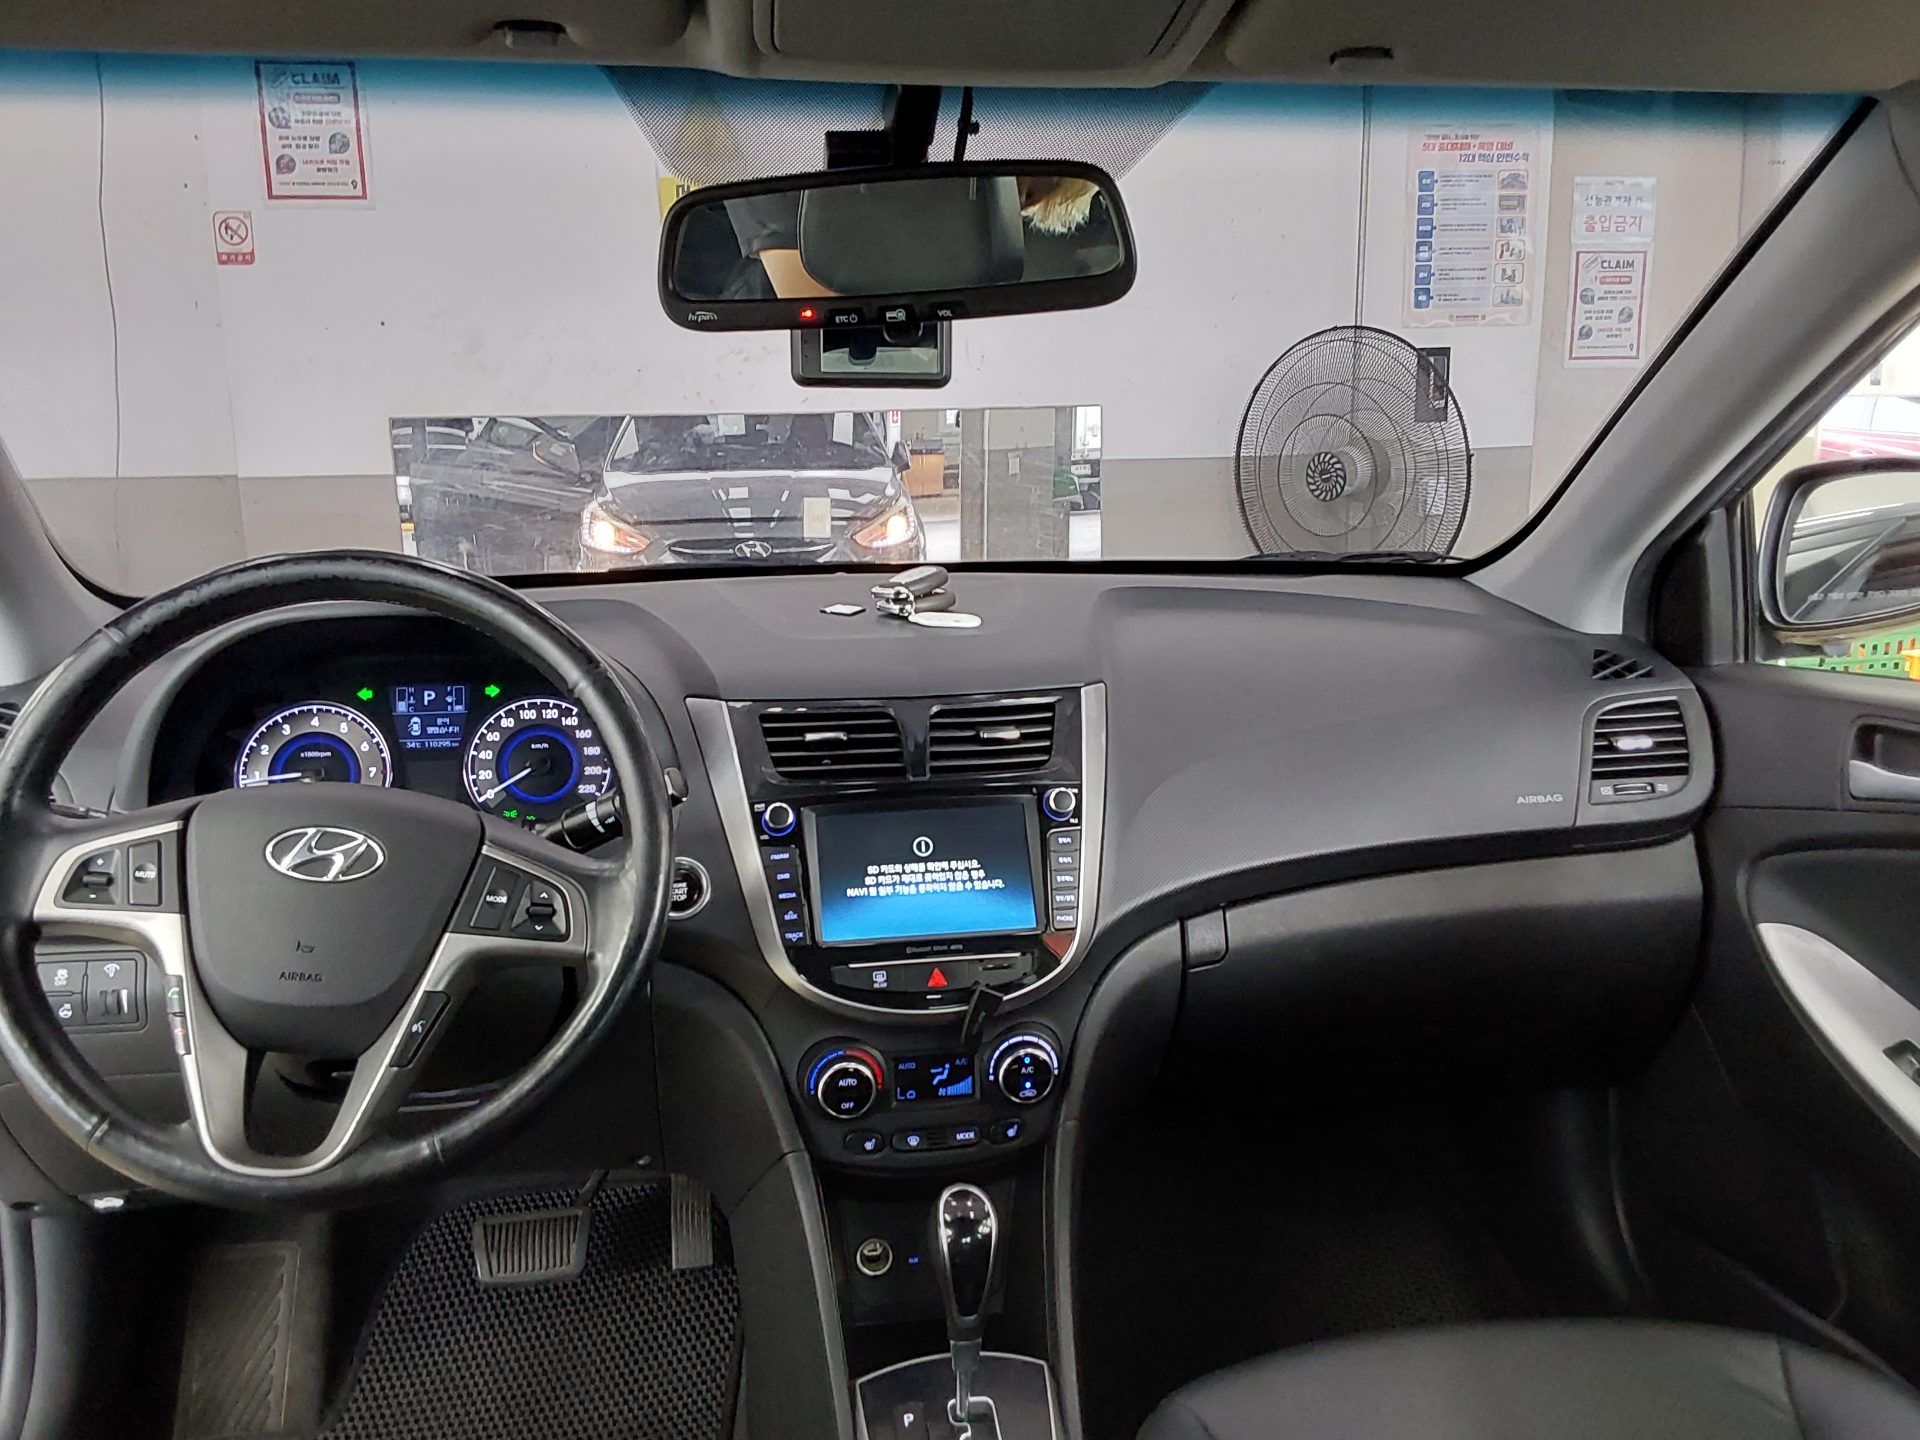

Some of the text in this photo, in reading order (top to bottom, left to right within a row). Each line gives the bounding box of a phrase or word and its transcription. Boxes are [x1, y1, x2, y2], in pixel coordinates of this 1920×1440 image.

[291, 72, 341, 84] CLAIM
[1583, 214, 1643, 233] 출입금지
[1600, 259, 1635, 269] CLAIM
[937, 309, 953, 318] VOL
[835, 315, 849, 324] ETC
[423, 690, 436, 706] P
[519, 710, 537, 720] 100
[541, 709, 559, 719] 120
[310, 716, 320, 727] 4
[500, 717, 514, 728] 80
[561, 716, 579, 726] 140
[282, 724, 291, 736] 3
[340, 722, 349, 734] 5
[486, 731, 500, 742] 60
[575, 729, 592, 739] 160
[260, 744, 270, 756] 2
[360, 741, 370, 752] 6
[583, 746, 601, 756] 180
[478, 749, 493, 760] 40
[368, 766, 377, 778] 7
[478, 769, 493, 780] 20
[584, 766, 602, 776] 200
[578, 784, 597, 794] 220
[1516, 793, 1563, 805] AIRBAG
[135, 870, 156, 878] MUTE
[867, 865, 880, 875] SD
[865, 876, 877, 885] SD
[847, 888, 868, 897] NAVI
[486, 895, 507, 903] MODE
[280, 971, 322, 982] AIRBAG
[898, 1062, 916, 1070] AUTO
[955, 1057, 969, 1066] A/C
[1021, 1066, 1034, 1074] A/C
[838, 1079, 857, 1087] AUTO
[841, 1102, 854, 1110] OFF
[956, 1131, 974, 1140] MODE
[903, 1413, 914, 1427] P
